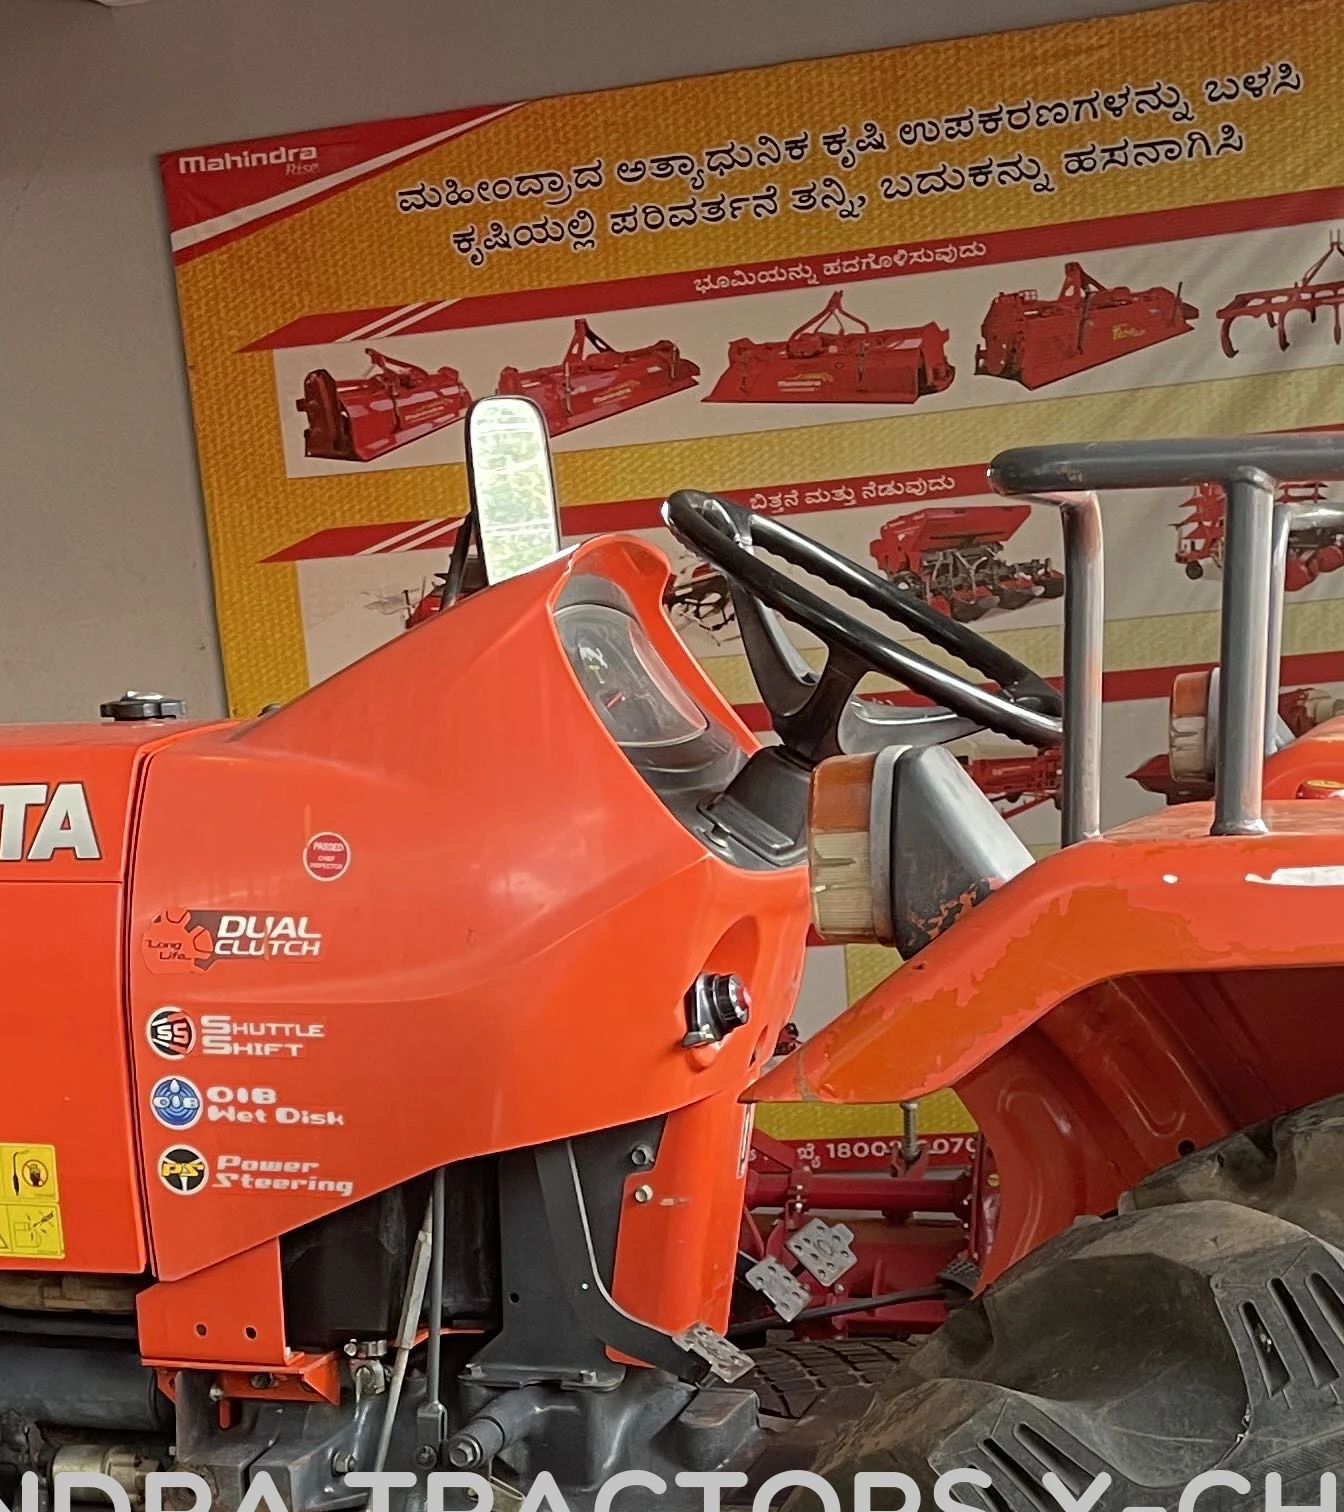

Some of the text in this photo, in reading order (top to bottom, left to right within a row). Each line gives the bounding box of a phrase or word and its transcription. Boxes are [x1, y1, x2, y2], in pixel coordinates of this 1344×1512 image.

[397, 62, 1302, 213] ಮಹೀಂದ್ರಾದ ಅತ್ಯಾಧುನಿಕ ಕೃಷಿ ಉಪಕರಣಗಳನ್ನು ಬಳಸಿ
[178, 146, 318, 174] Mahindra
[451, 208, 596, 267] ಕೃಷಿಯಲ್ಲಿ
[609, 184, 779, 236] ಪರಿವರ್ತನೆ
[879, 152, 1055, 200] ಬದುಕನ್ನು
[1063, 123, 1245, 175] ಹಸನಾಗಿಸಿ
[693, 241, 987, 295] ಭೂಮಿಯನ್ನು ಹದಗೊಳಿಸುವುದು
[804, 485, 857, 506] ಮತ್ತು
[861, 475, 956, 500] ನೆಡುವುದು
[217, 915, 323, 939] DUAL
[214, 940, 321, 957] CLUTCH
[200, 1015, 326, 1038] SHUTTLE
[202, 1035, 304, 1057] SHIFT
[206, 1086, 277, 1105] OIB
[207, 1105, 345, 1126] Wet Disk
[217, 1155, 320, 1174] Power
[212, 1173, 354, 1197] Steering
